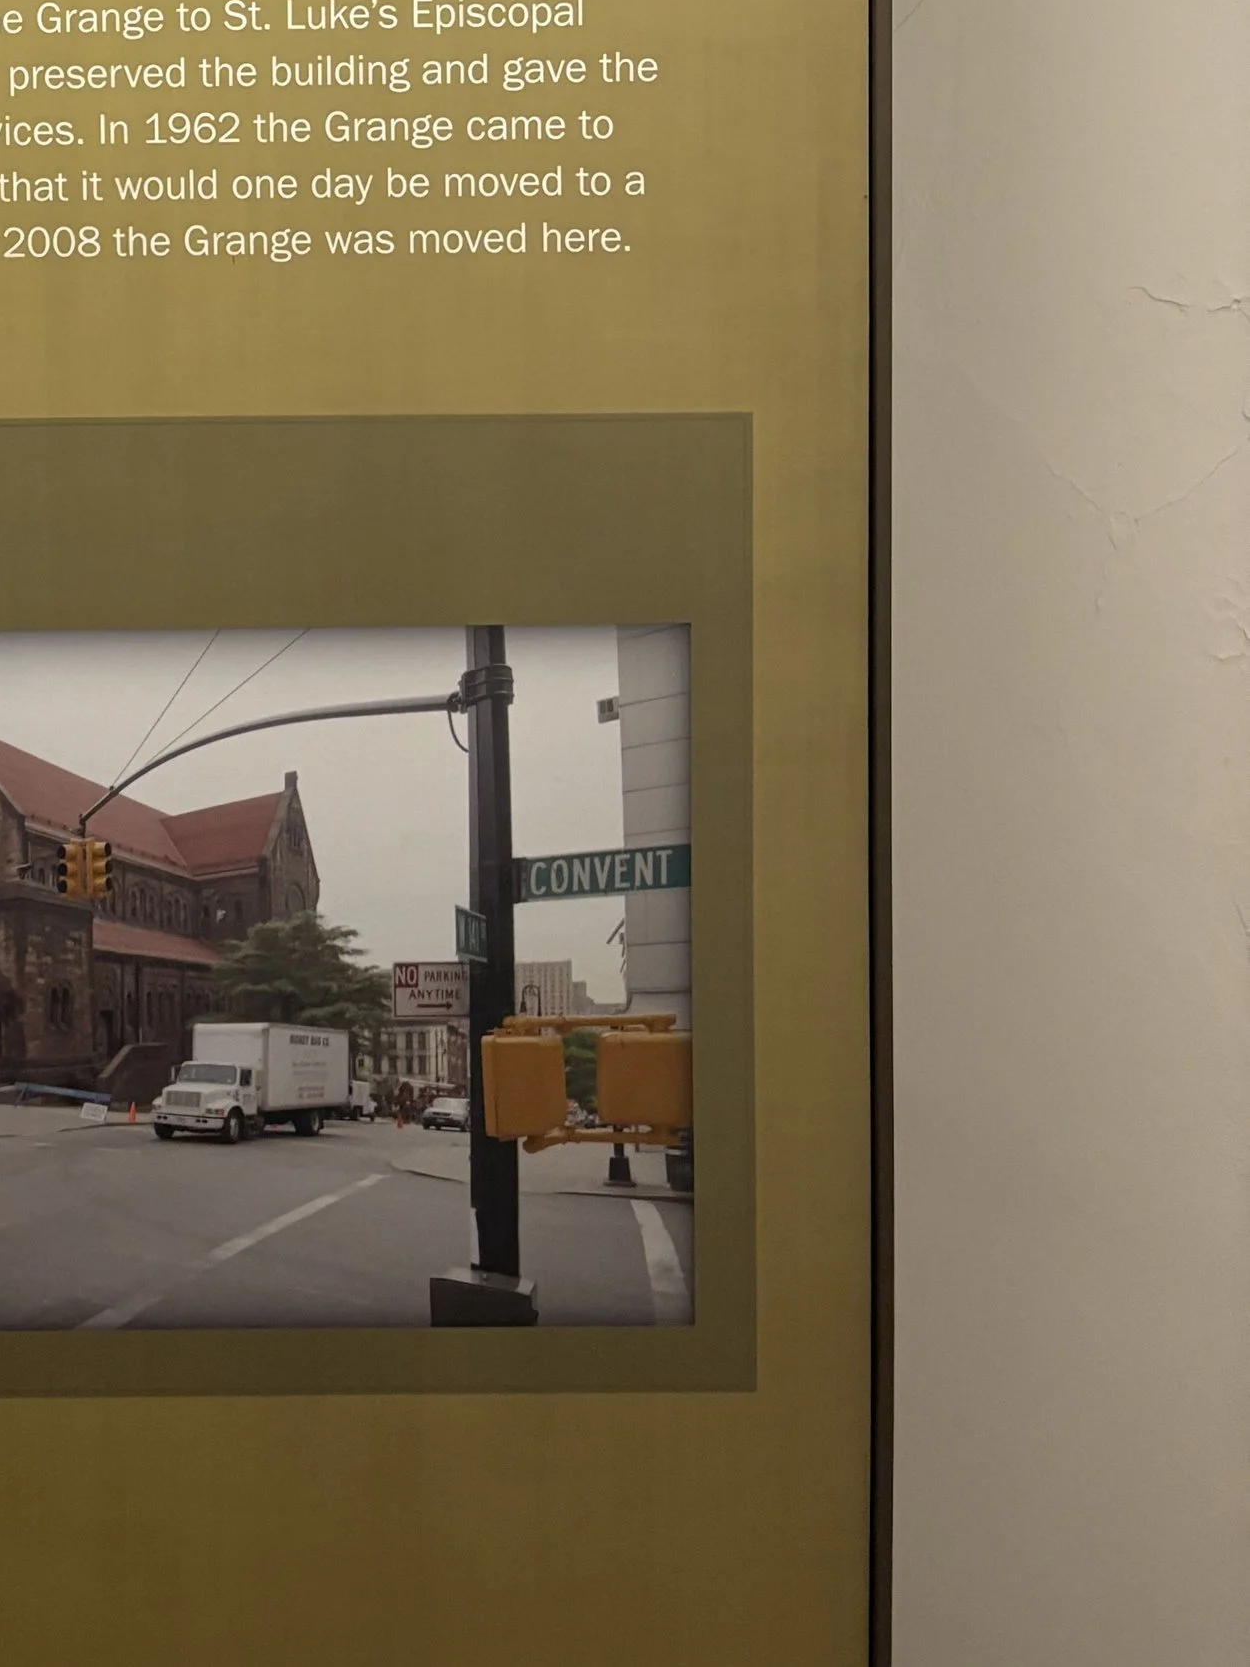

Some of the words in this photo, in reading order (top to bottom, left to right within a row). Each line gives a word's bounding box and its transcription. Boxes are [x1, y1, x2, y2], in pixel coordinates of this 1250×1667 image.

[37, 2, 163, 39] Grange
[176, 3, 210, 31] to
[224, 0, 270, 30] St.
[10, 57, 185, 96] preserved
[199, 57, 257, 87] the
[272, 55, 410, 92] building
[423, 53, 487, 84] and
[503, 57, 586, 91] gave
[599, 52, 658, 82] the
[100, 114, 128, 144] In
[146, 112, 240, 143] 1962
[253, 112, 311, 143] the
[325, 111, 453, 148] Grange
[467, 116, 565, 140] came
[578, 110, 613, 139] to
[82, 171, 103, 201] it
[115, 169, 217, 200] would
[232, 175, 297, 199] one
[312, 168, 373, 205] day
[388, 167, 429, 198] be
[445, 166, 561, 197] moved
[575, 167, 611, 196] to
[625, 172, 644, 195] a
[4, 226, 100, 257] 2008
[113, 226, 170, 257] the
[185, 225, 311, 262] Grange
[325, 231, 394, 254] was
[410, 222, 526, 253] moved
[543, 222, 630, 252] here.
[529, 849, 673, 895] CONVENT
[395, 966, 418, 985] NO
[424, 969, 468, 983] PARKING
[409, 988, 462, 1001] ANYTIME
